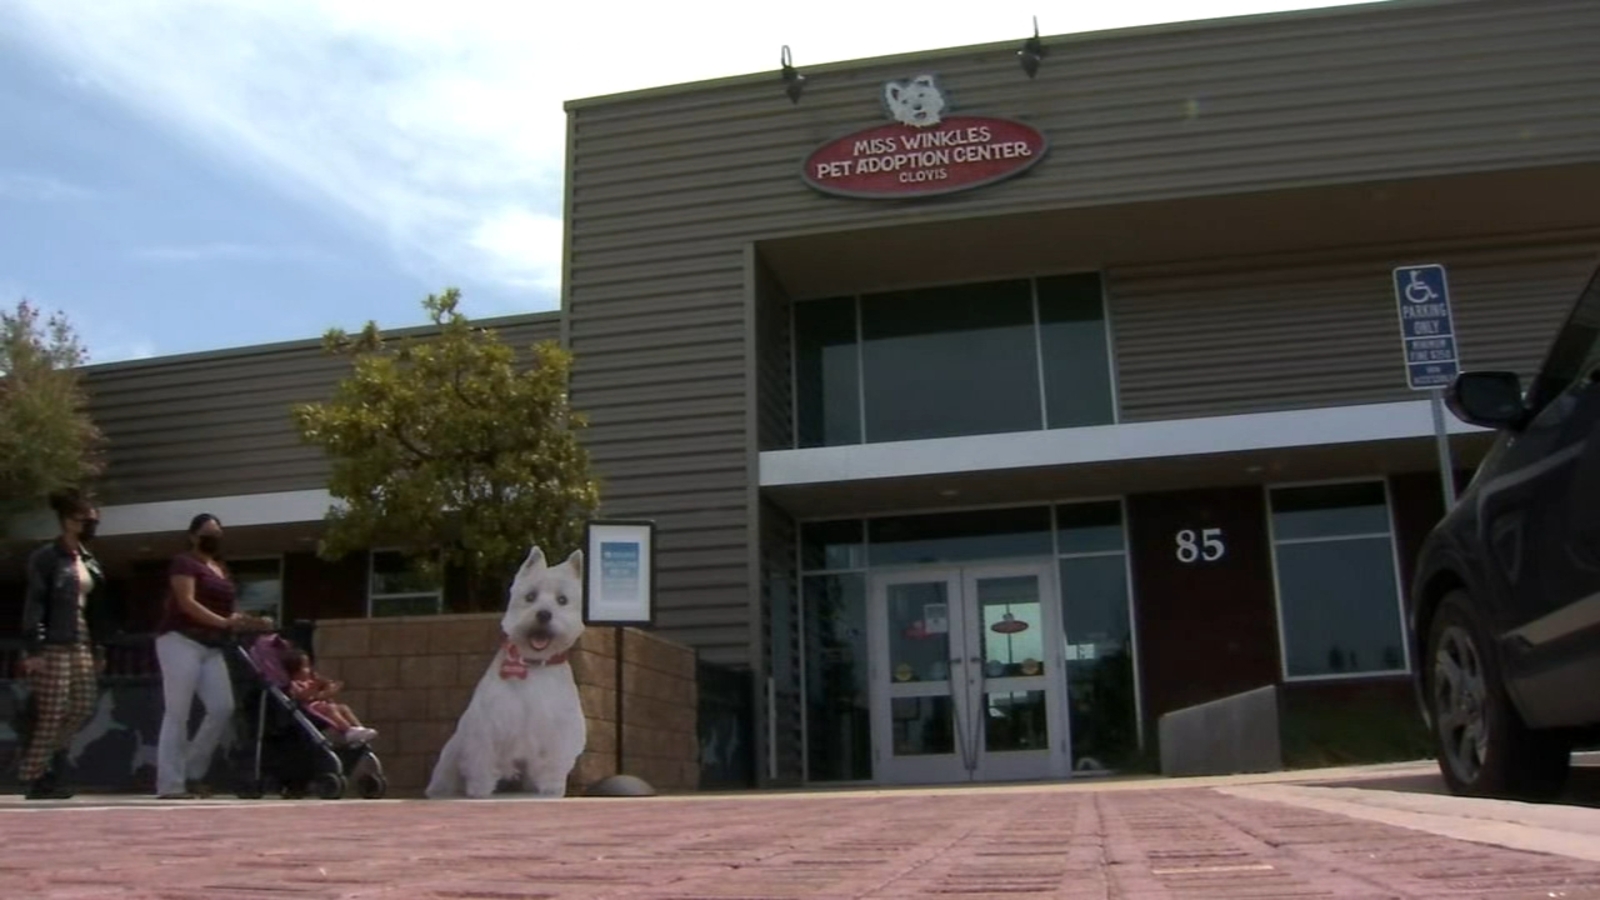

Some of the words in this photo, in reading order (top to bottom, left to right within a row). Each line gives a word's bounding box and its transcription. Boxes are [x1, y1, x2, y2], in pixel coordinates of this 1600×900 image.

[853, 138, 896, 156] MISS
[901, 126, 991, 150] WINKLES
[817, 161, 852, 179] PET
[856, 150, 950, 174] ADOPTION
[954, 141, 1031, 162] CENTER
[899, 168, 948, 183] CLOVIS
[1403, 303, 1447, 319] PARKING
[1414, 320, 1440, 335] ONLY
[1175, 528, 1225, 563] 85
